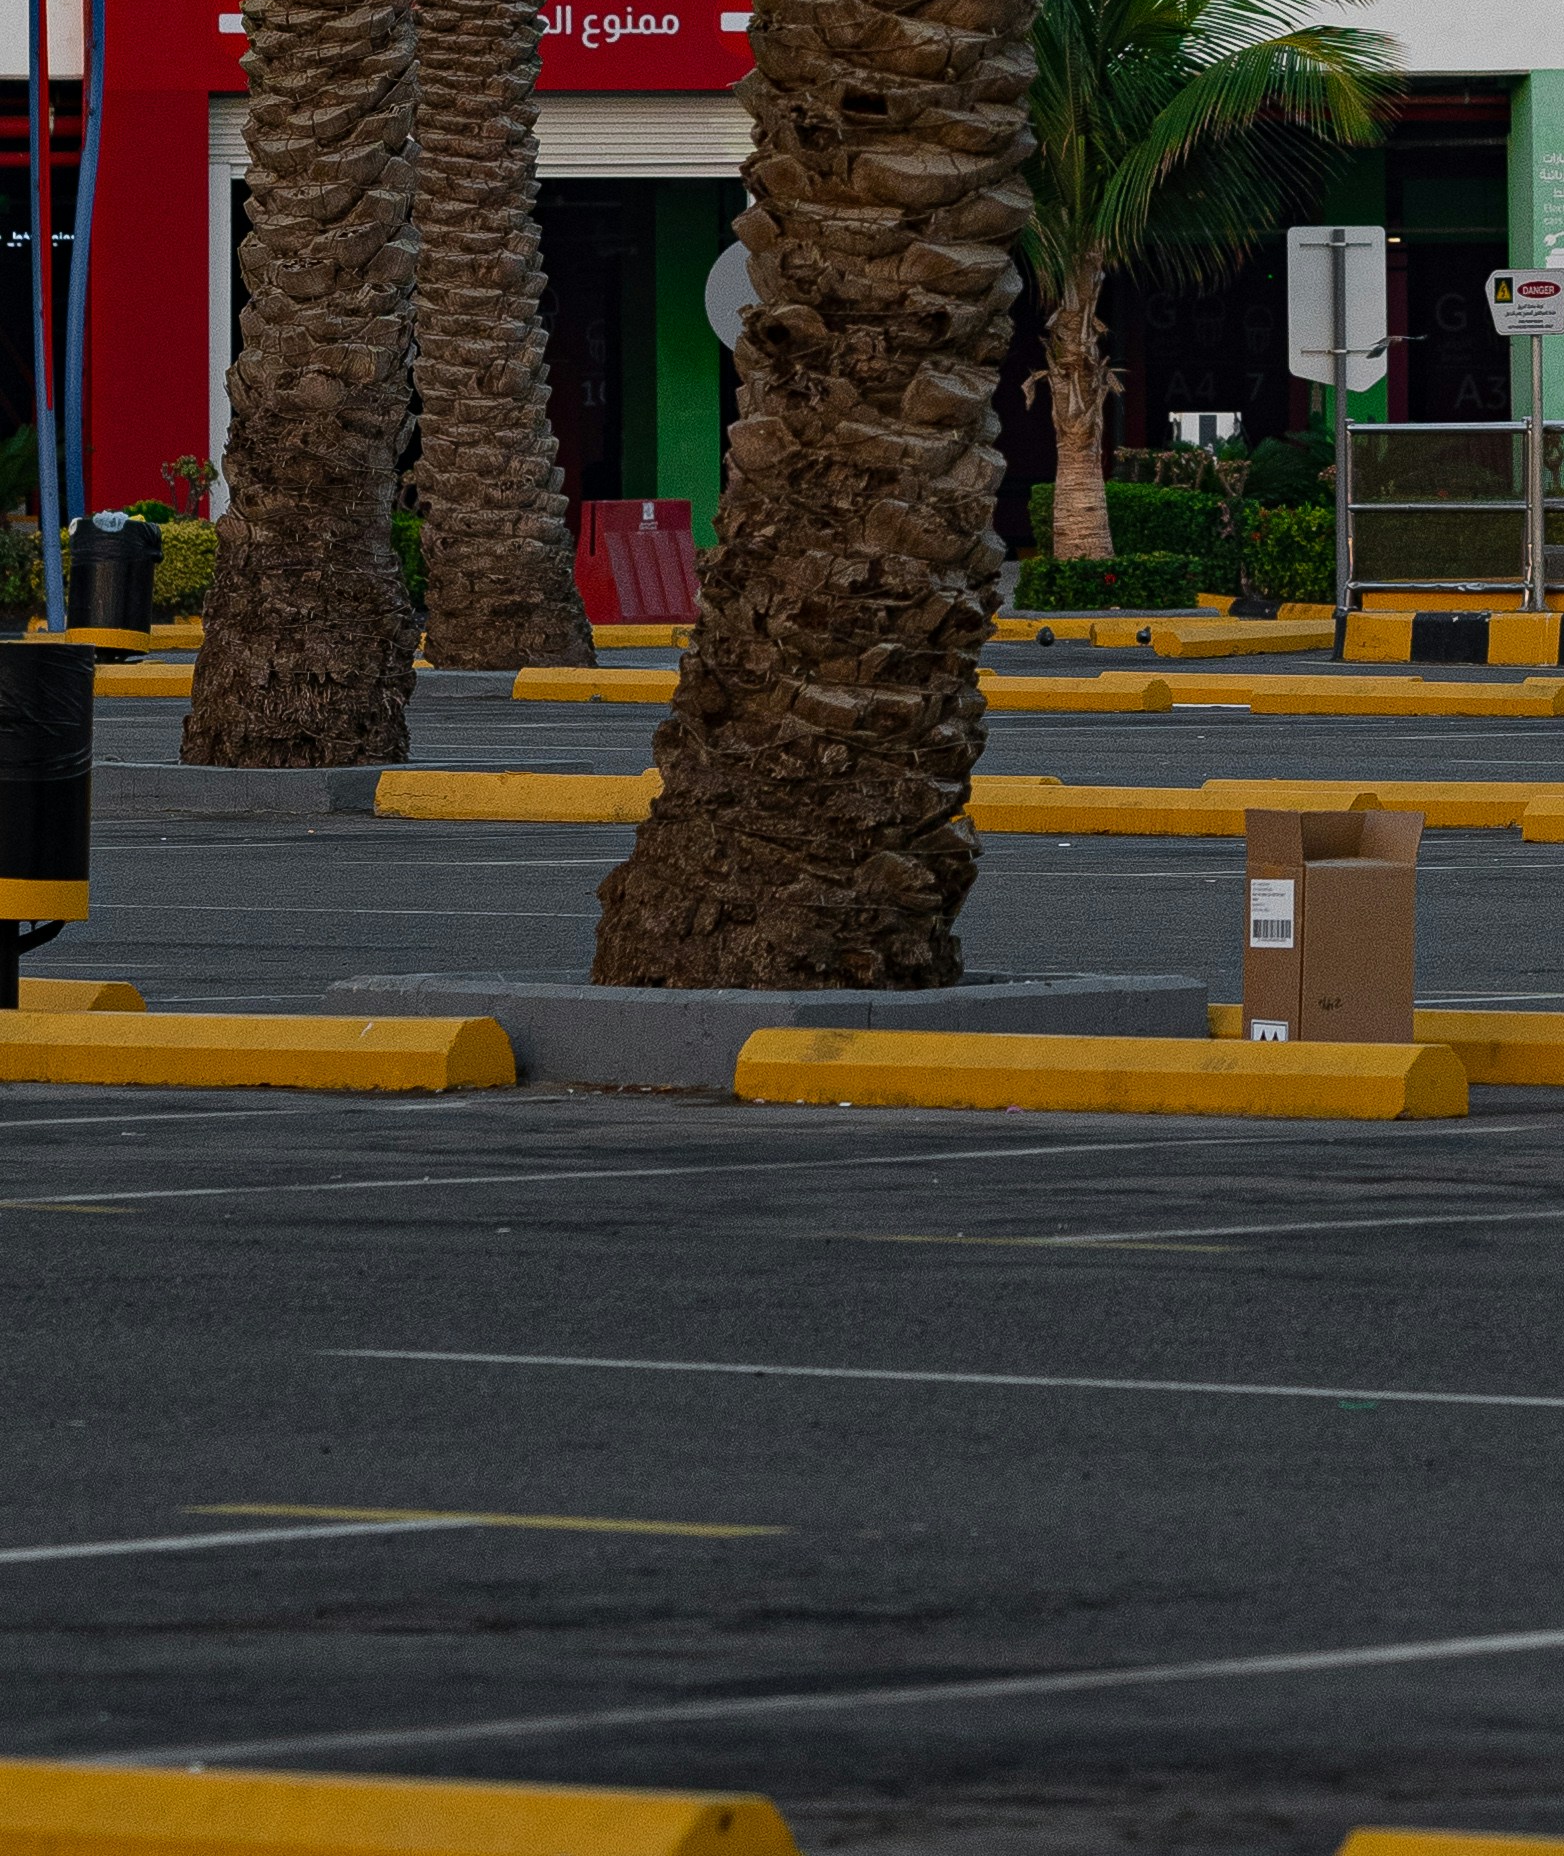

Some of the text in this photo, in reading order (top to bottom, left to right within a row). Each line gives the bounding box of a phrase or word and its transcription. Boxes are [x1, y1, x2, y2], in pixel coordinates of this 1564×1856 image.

[581, 6, 680, 49] ممنوع
[1522, 286, 1555, 295] DANGER
[1454, 374, 1507, 410] A3
